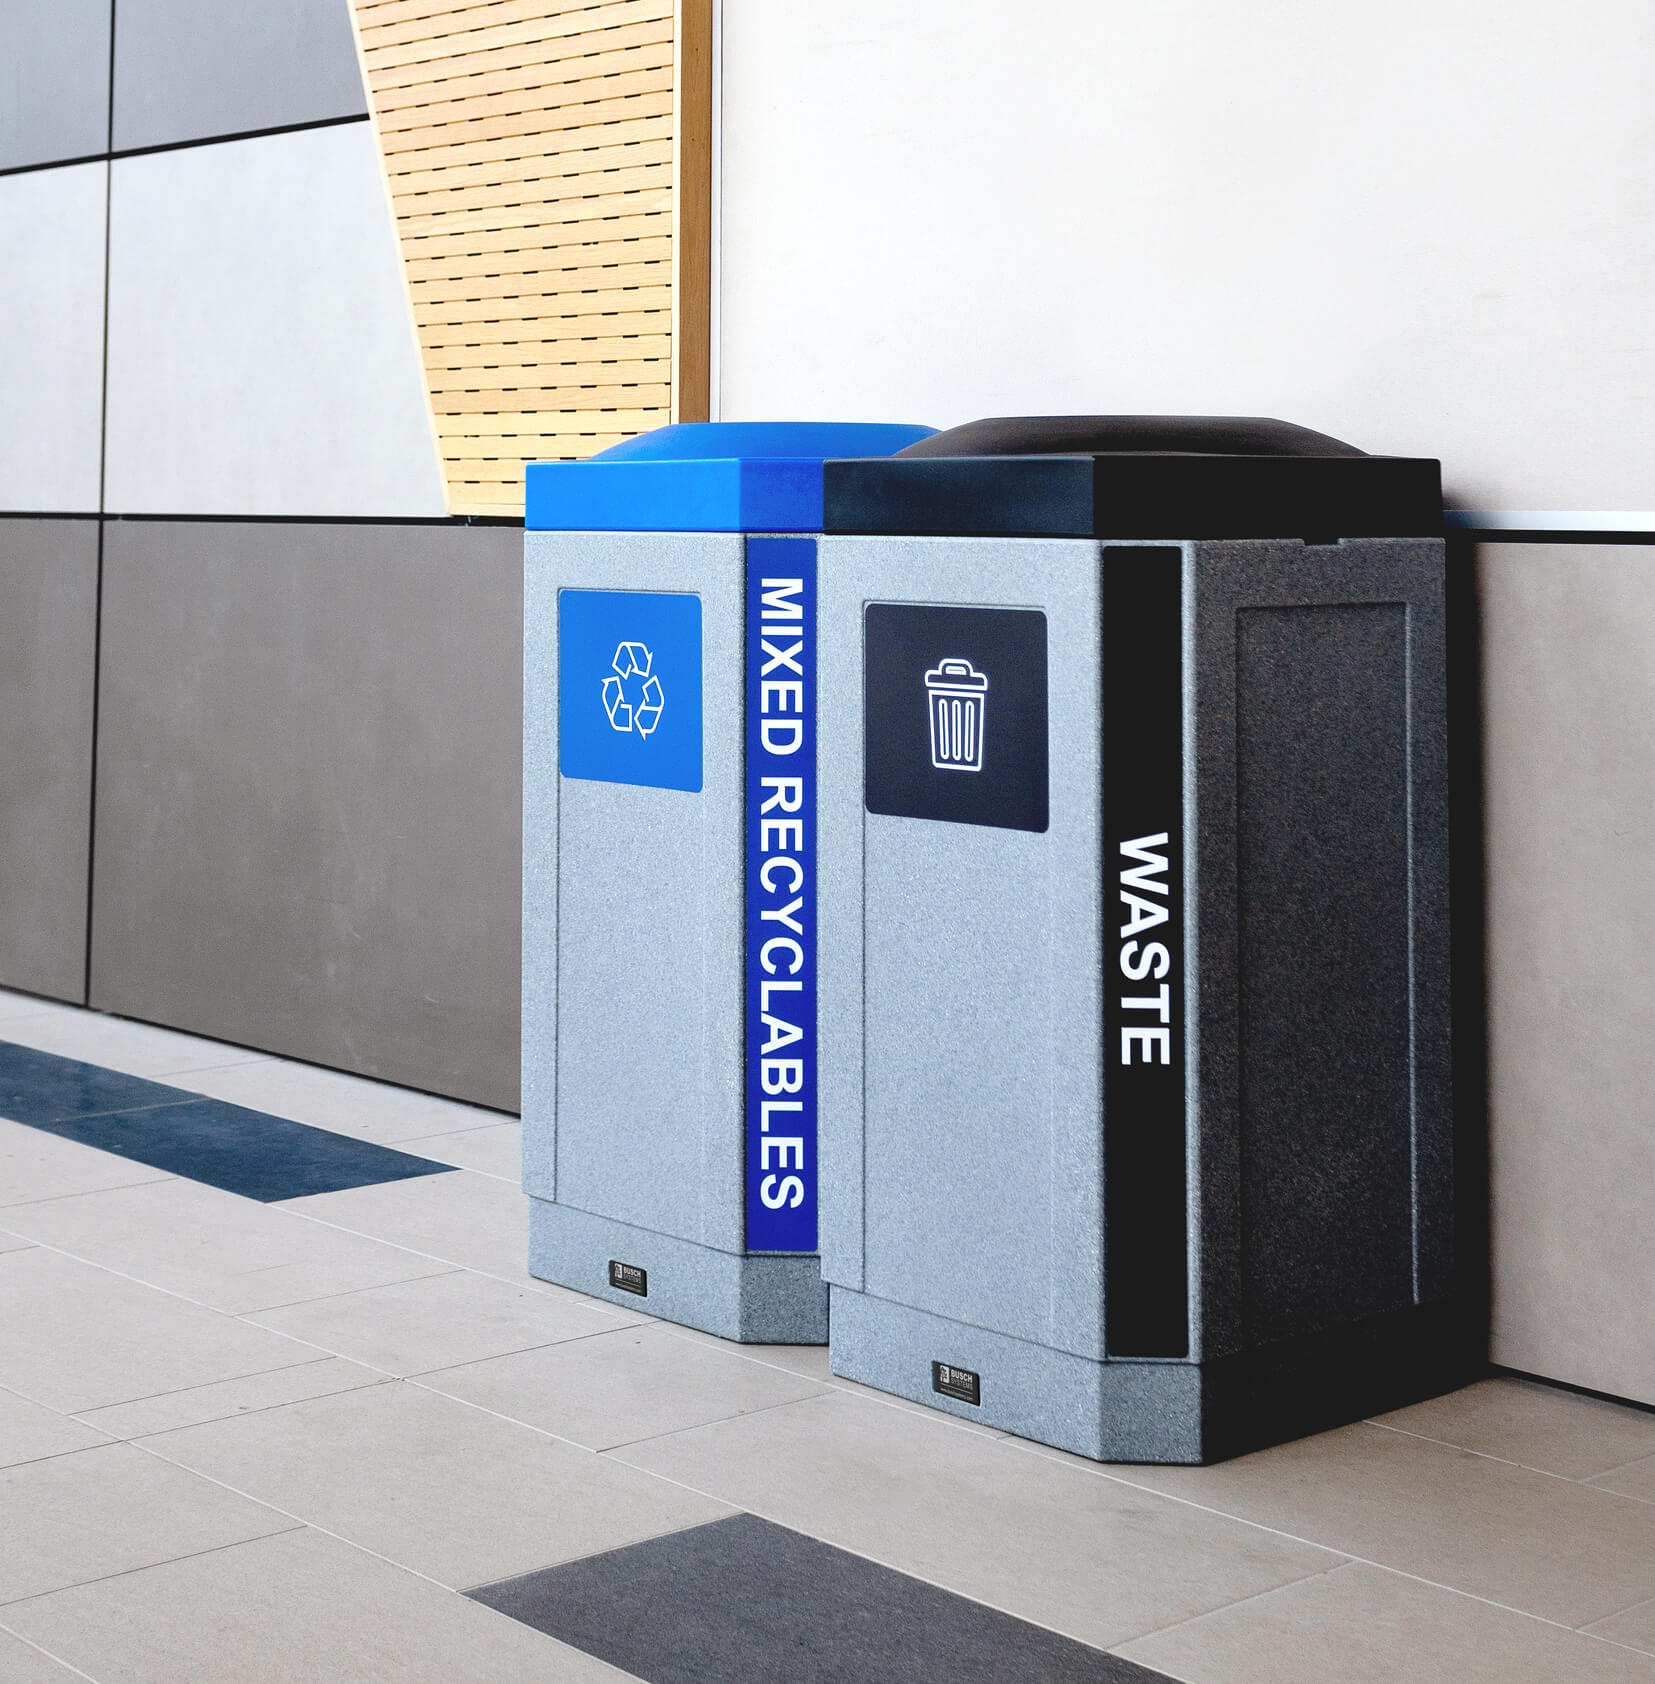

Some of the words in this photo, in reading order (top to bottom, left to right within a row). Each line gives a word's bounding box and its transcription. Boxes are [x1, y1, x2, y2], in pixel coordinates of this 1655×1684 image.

[761, 579, 803, 755] MIXED
[761, 777, 804, 1209] RECYCLABLES
[1120, 833, 1169, 1064] WASTE
[623, 1266, 641, 1277] BUSCH
[951, 1369, 973, 1384] BUSCH
